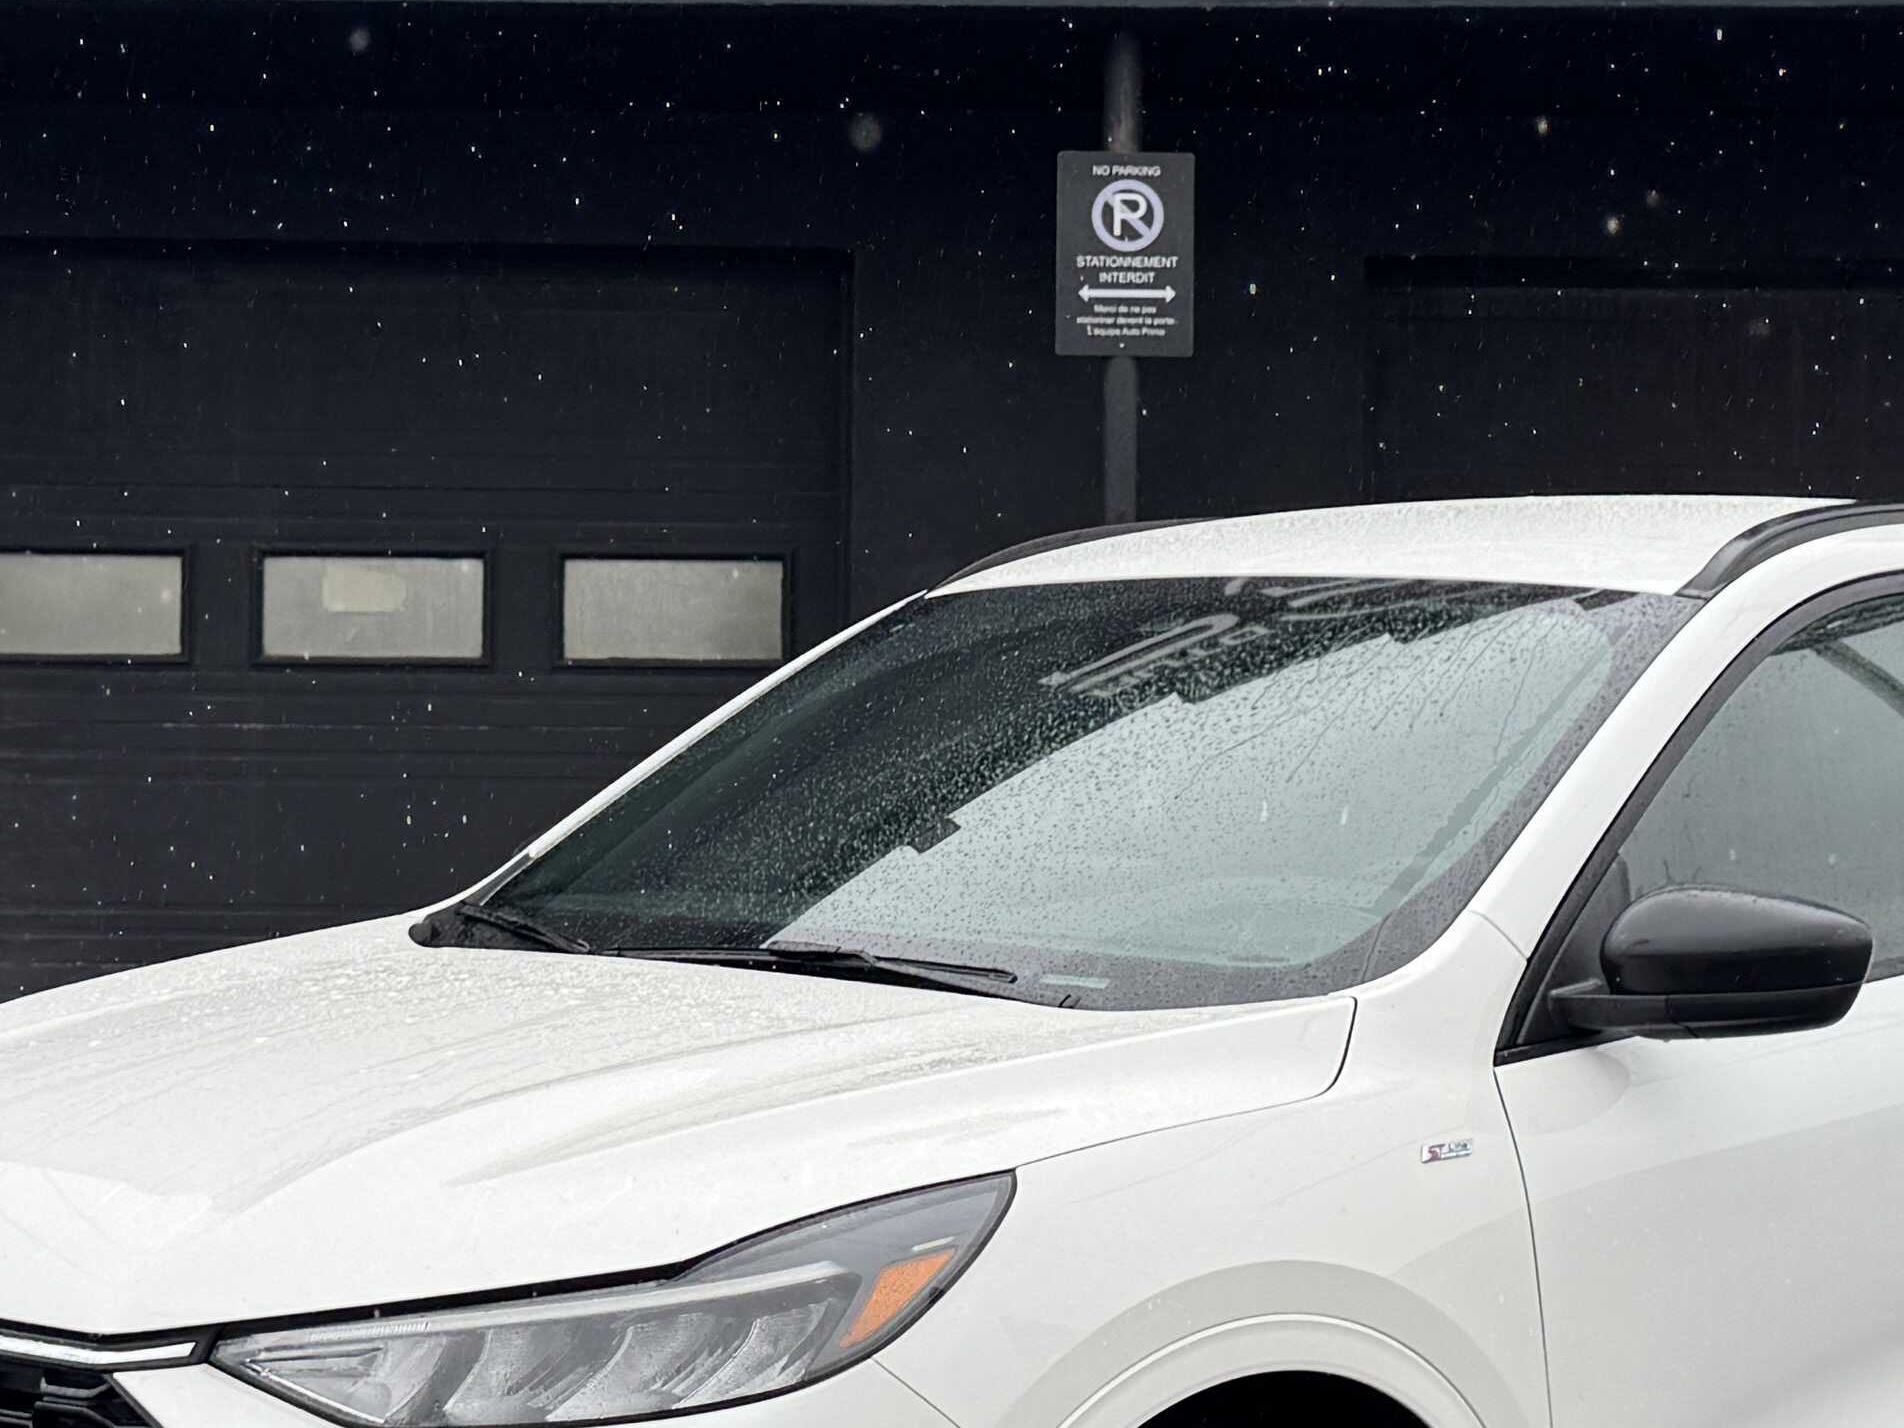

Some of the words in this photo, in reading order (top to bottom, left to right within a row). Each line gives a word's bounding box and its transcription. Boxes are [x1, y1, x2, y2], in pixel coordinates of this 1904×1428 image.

[1092, 165, 1110, 176] NO
[1112, 165, 1162, 176] PARKING
[1076, 255, 1178, 268] STATIONNEMENT
[1099, 271, 1156, 284] INTERDIT
